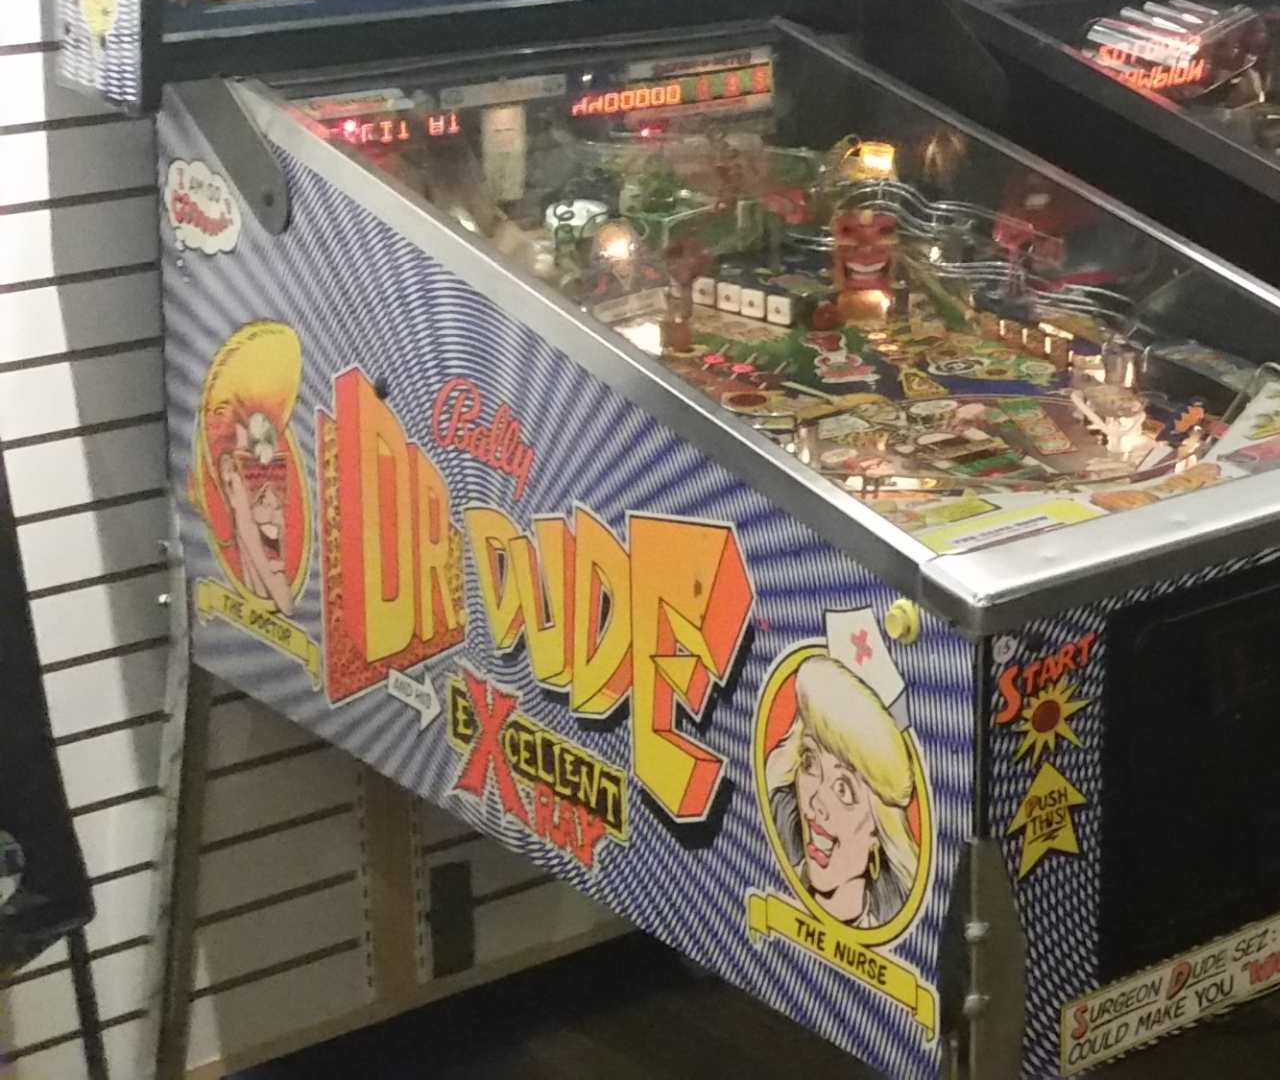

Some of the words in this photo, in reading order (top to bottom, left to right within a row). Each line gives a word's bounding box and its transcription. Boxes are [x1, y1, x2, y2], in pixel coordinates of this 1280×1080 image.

[432, 377, 536, 502] Bally
[223, 594, 243, 620] THE
[249, 609, 292, 642] DOCTOR
[463, 505, 754, 820] DUDE
[992, 631, 1098, 726] START
[450, 668, 627, 835] EXCELLENT
[1024, 787, 1069, 818] PUSH
[794, 917, 826, 953] THE
[834, 940, 889, 986] NURSE
[1070, 976, 1164, 1040] SURGEON
[1166, 948, 1228, 1001] DUDE
[1068, 1022, 1129, 1066] COULD
[1135, 995, 1188, 1036] MAKE
[1194, 974, 1235, 1009] YOU
